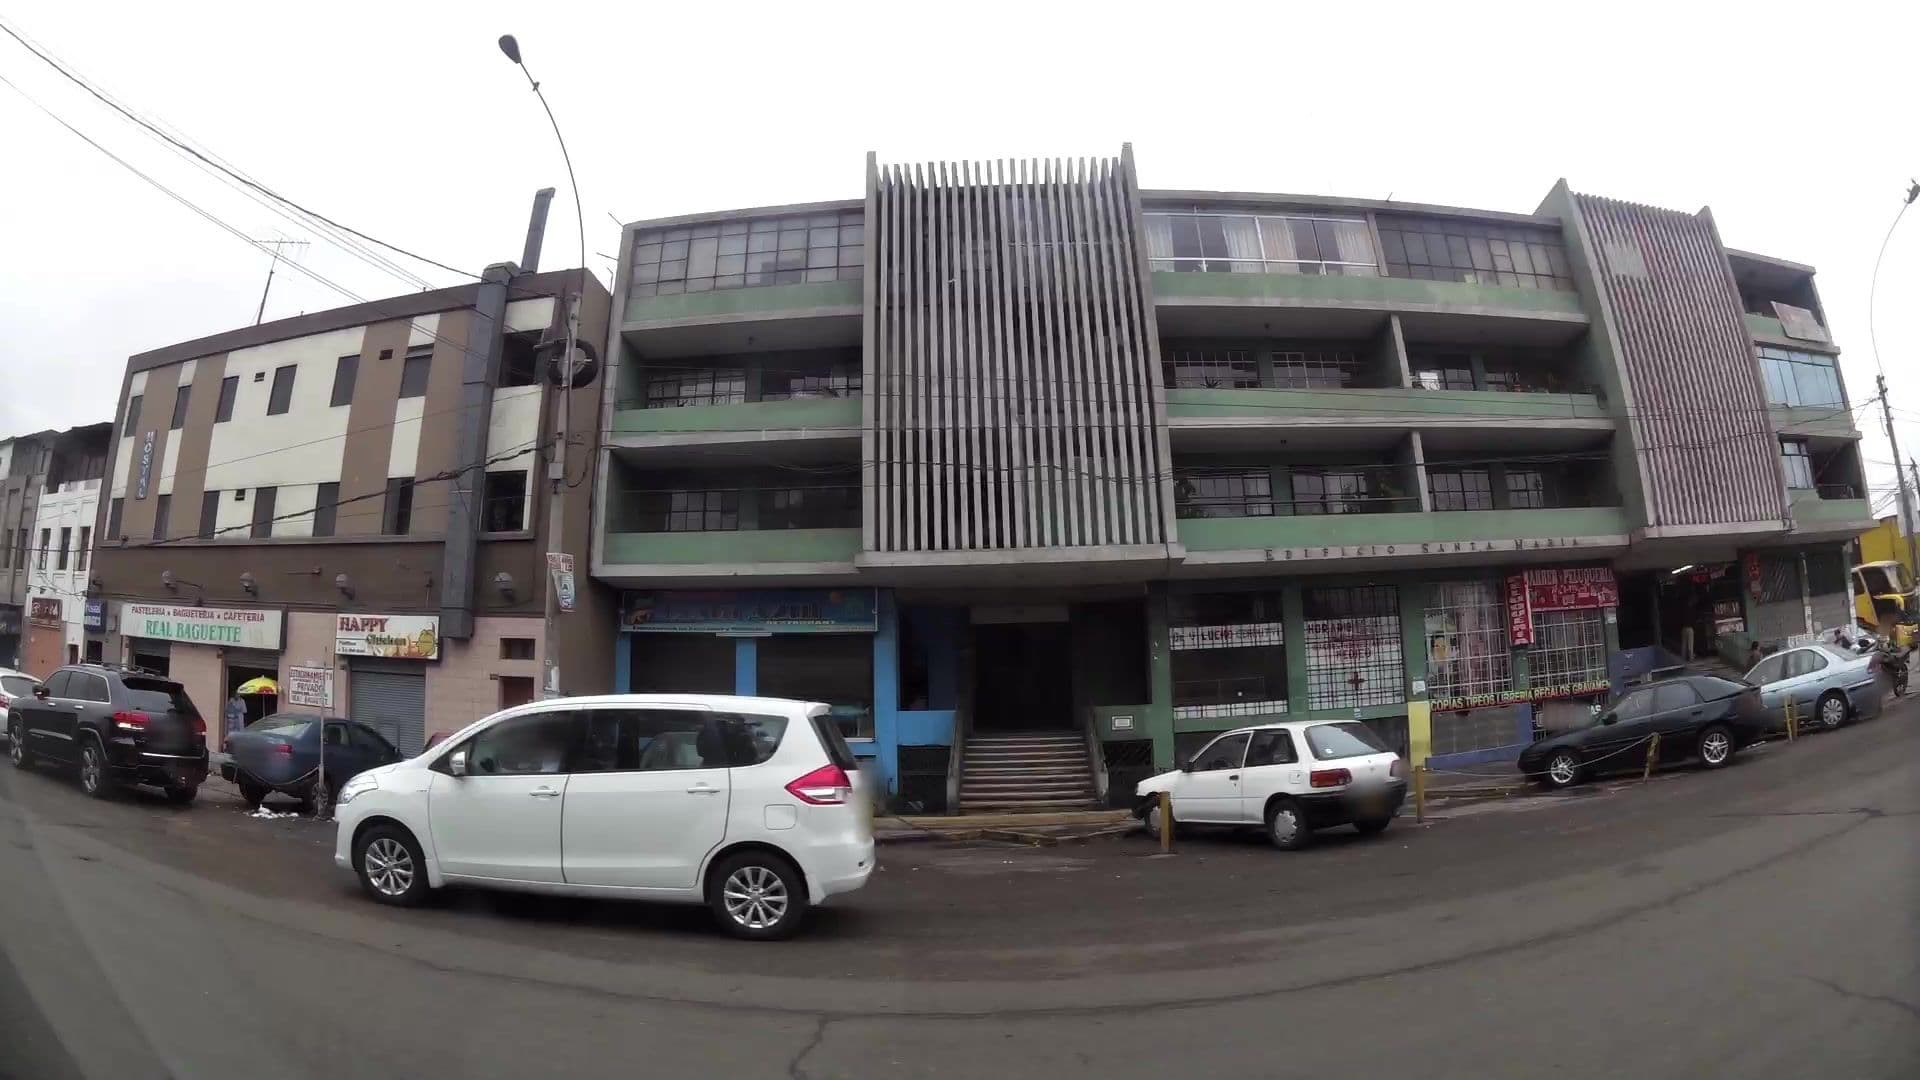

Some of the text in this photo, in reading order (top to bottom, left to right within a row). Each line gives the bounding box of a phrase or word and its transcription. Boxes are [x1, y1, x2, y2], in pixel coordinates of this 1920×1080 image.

[1264, 537, 1579, 560] EDIFICIO SANTA MARIA
[131, 606, 265, 623] PASTELERIA BAGUETERIA CAFETERIA
[339, 616, 390, 632] HAPPY
[145, 619, 241, 642] REAL BAGUETTE
[1430, 697, 1464, 712] COPIAS
[1466, 694, 1495, 708] TIPEOS
[1496, 688, 1534, 705] LIBRERIA
[1534, 684, 1570, 700] REGALOS
